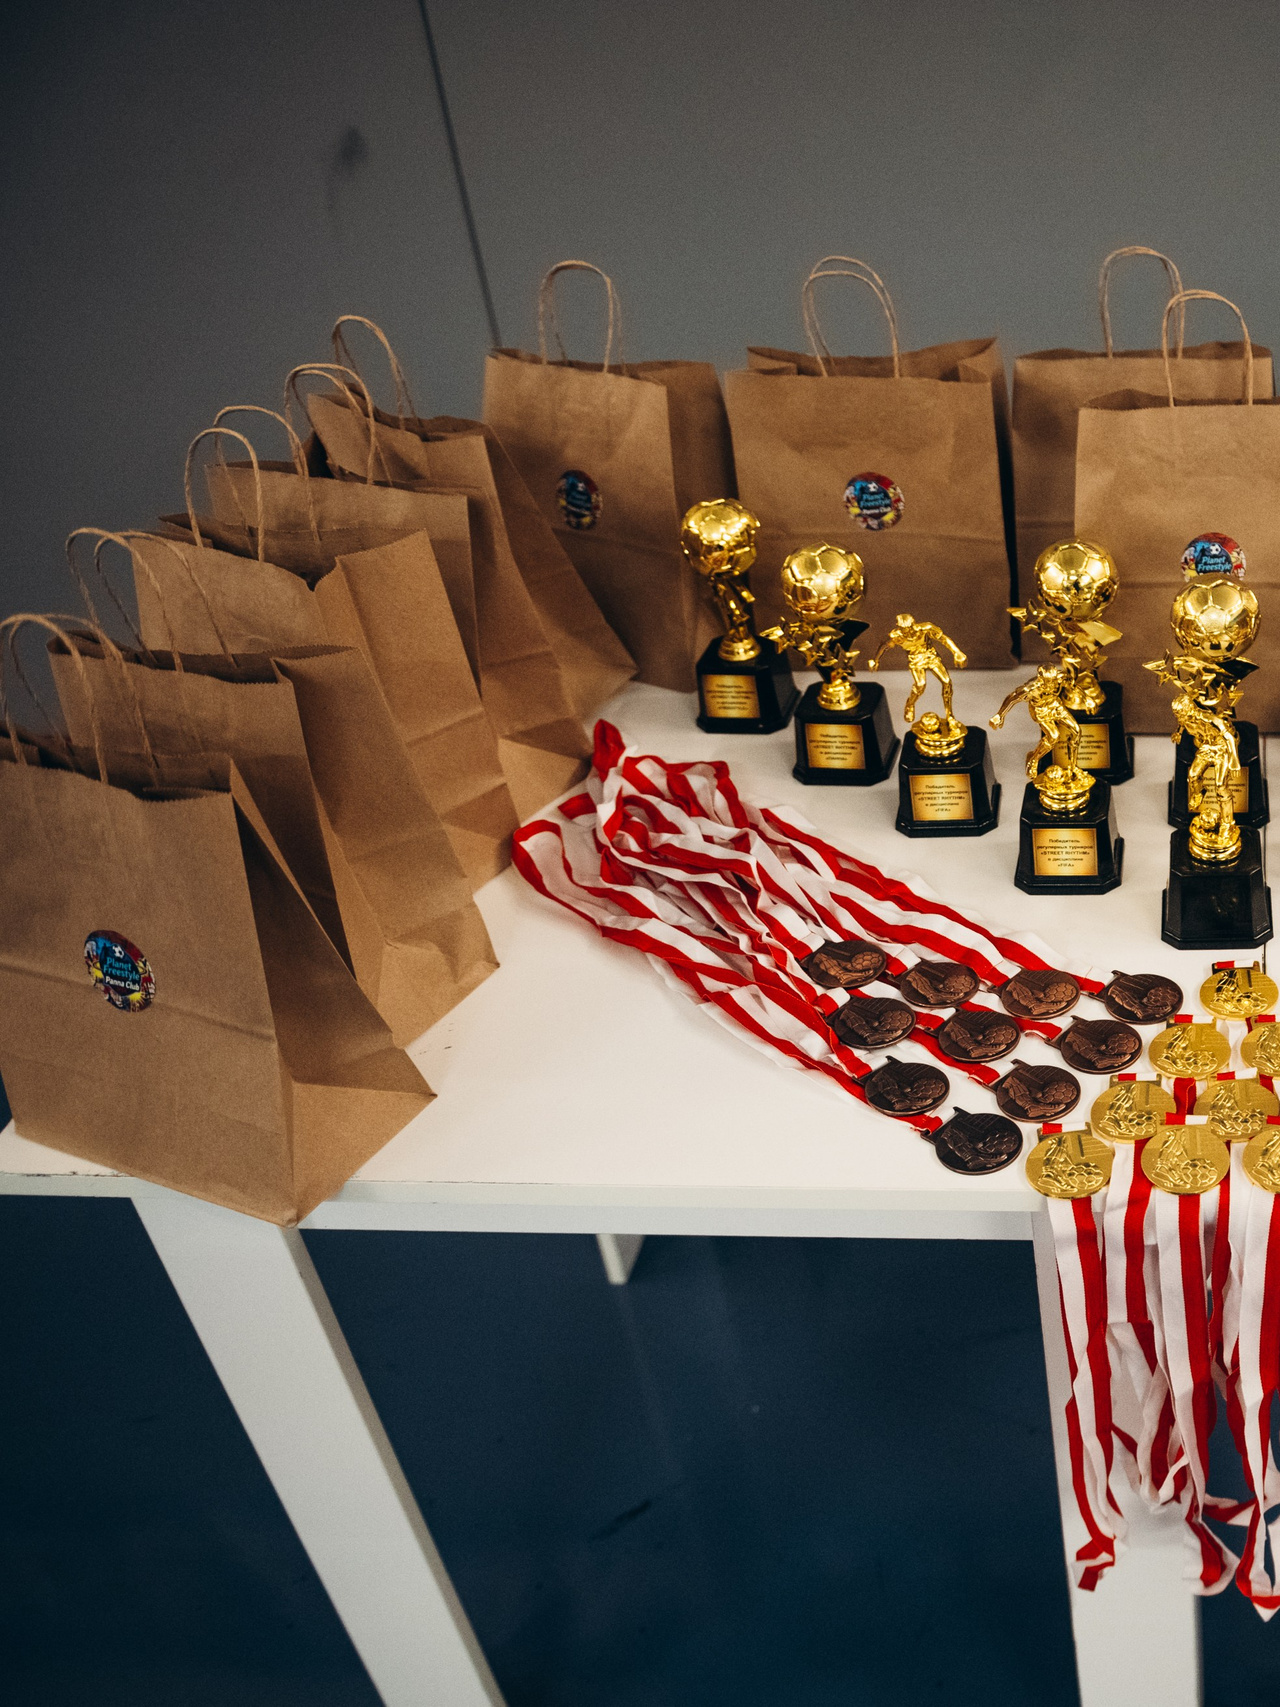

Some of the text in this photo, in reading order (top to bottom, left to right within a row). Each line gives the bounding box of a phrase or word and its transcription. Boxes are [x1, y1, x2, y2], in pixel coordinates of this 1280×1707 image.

[860, 498, 891, 508] Freestyle
[1202, 556, 1226, 564] Planet
[1197, 562, 1232, 572] Freestyle
[106, 957, 132, 971] Planet
[103, 965, 140, 981] Freestyle
[105, 976, 140, 991] Panna Club
